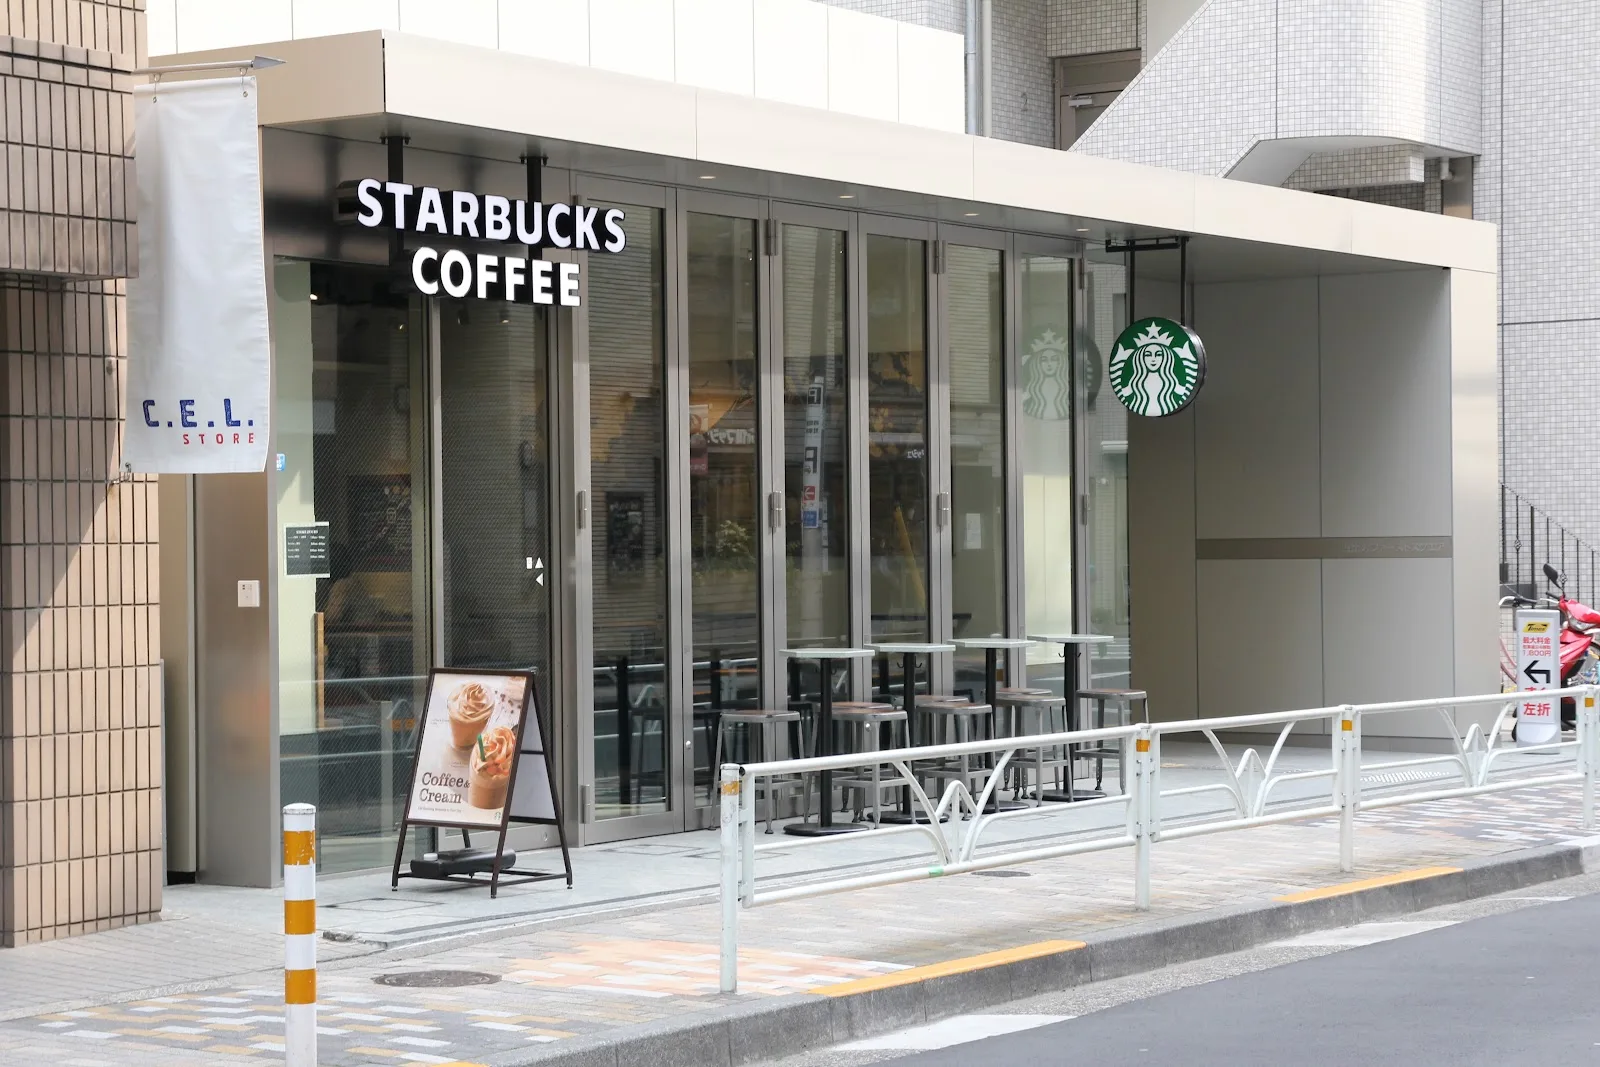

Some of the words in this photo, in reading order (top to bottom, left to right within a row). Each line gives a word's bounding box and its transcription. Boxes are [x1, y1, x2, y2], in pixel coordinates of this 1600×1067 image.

[357, 178, 626, 253] STARBUCKS
[412, 247, 581, 306] COFFEE
[142, 398, 254, 428] C.E.L.
[183, 432, 255, 445] STORE
[1522, 636, 1551, 645] 最大料金
[1523, 702, 1551, 717] 左折
[418, 788, 462, 804] Cream
